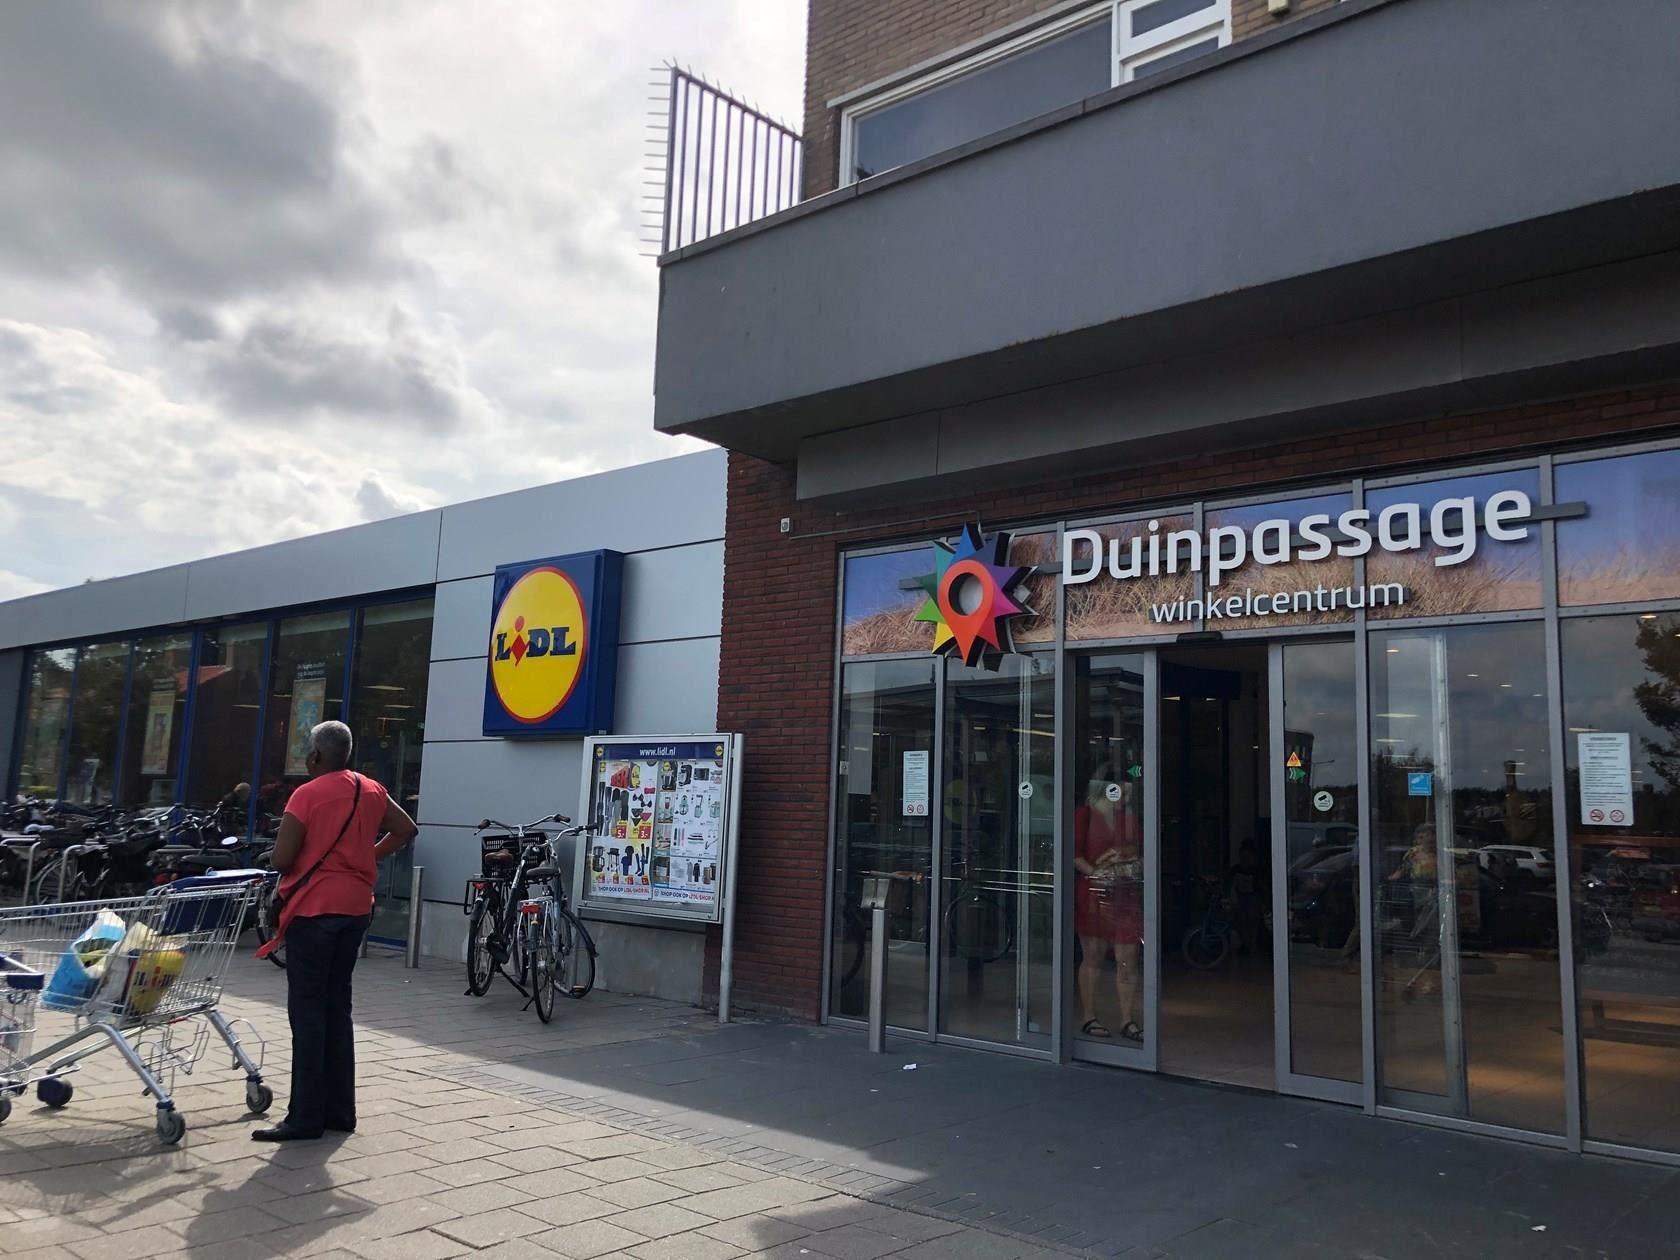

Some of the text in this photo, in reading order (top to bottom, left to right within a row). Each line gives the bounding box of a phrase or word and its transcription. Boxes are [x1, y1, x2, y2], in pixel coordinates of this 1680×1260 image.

[1062, 489, 1532, 586] Duinpassage
[1151, 581, 1404, 624] winkelcentrum
[639, 746, 676, 756] www.lidl.nl
